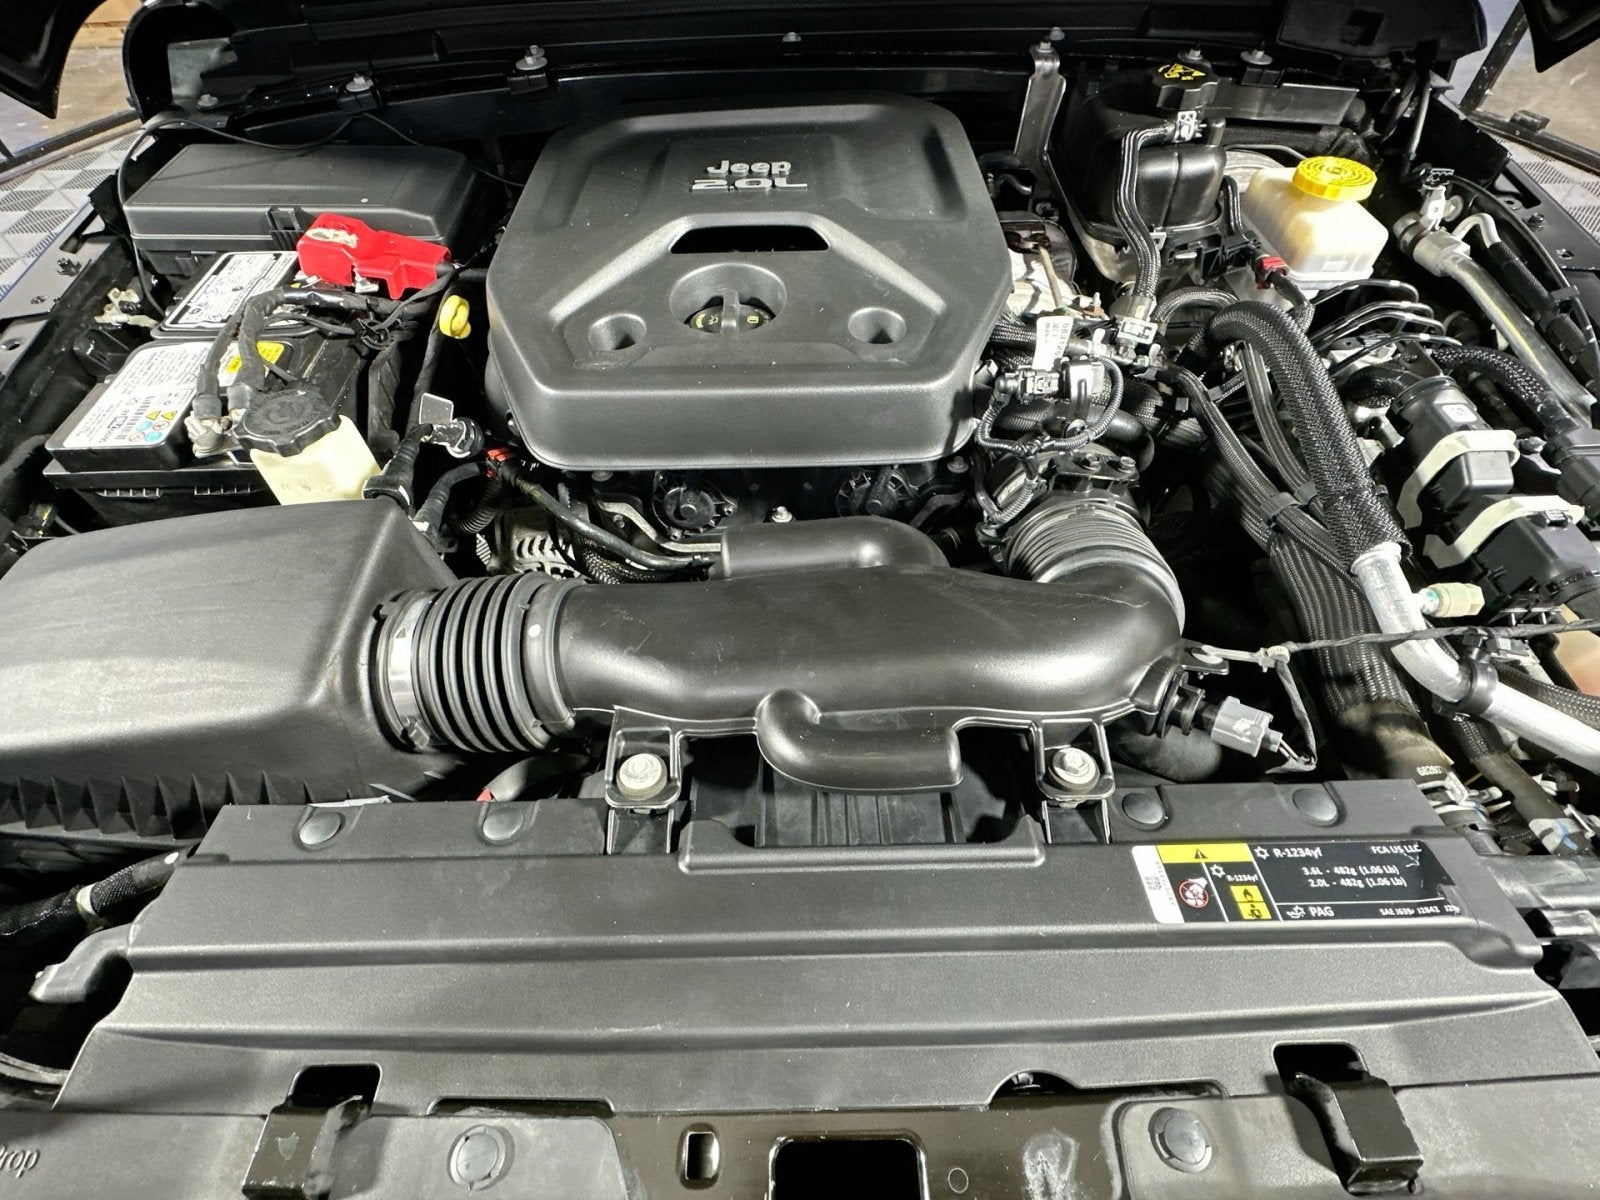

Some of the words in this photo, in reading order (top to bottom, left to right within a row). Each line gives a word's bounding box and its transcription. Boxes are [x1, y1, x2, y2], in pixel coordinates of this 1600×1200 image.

[706, 160, 791, 175] Jeep
[692, 178, 808, 190] 2.0L
[1273, 846, 1322, 859] R-1234yf
[1371, 845, 1390, 854] FCA
[1390, 845, 1404, 854] US
[1404, 844, 1422, 853] LLC
[1383, 864, 1399, 875] Lb)
[1308, 879, 1330, 888] 2.0L
[1366, 877, 1390, 888] (1.06
[1390, 877, 1407, 887] Lb)
[1309, 906, 1335, 917] PAG
